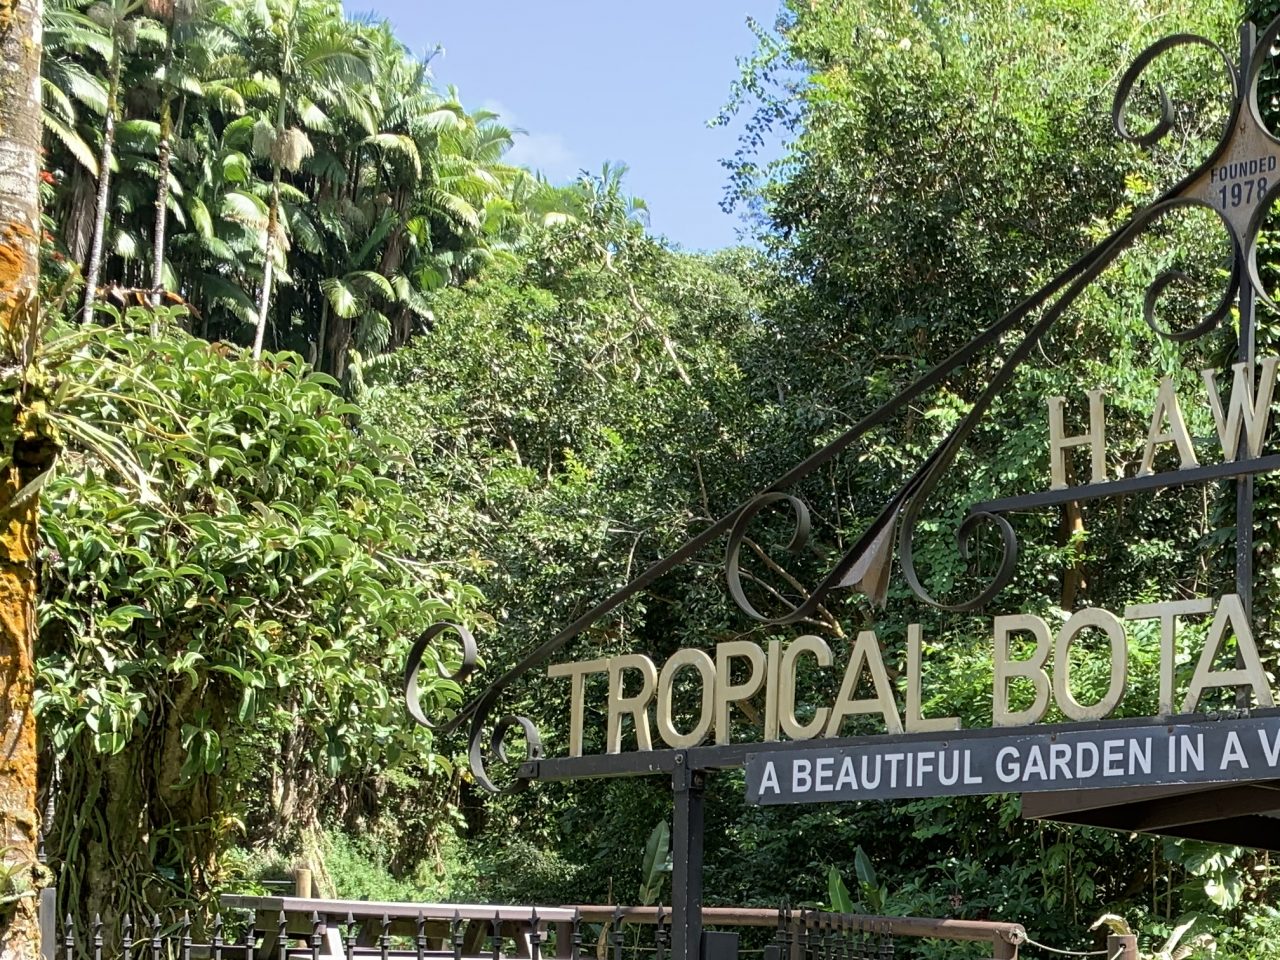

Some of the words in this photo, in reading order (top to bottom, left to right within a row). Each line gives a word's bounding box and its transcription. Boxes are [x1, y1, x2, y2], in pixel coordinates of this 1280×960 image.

[1210, 155, 1277, 184] FOUNDED
[1219, 177, 1268, 210] 1978
[548, 623, 962, 758] TROPICAL
[758, 761, 781, 795] A
[792, 748, 983, 794] BEAUTIFUL
[995, 738, 1155, 782] GARDEN
[1168, 733, 1204, 773] IN
[1219, 730, 1250, 769] A
